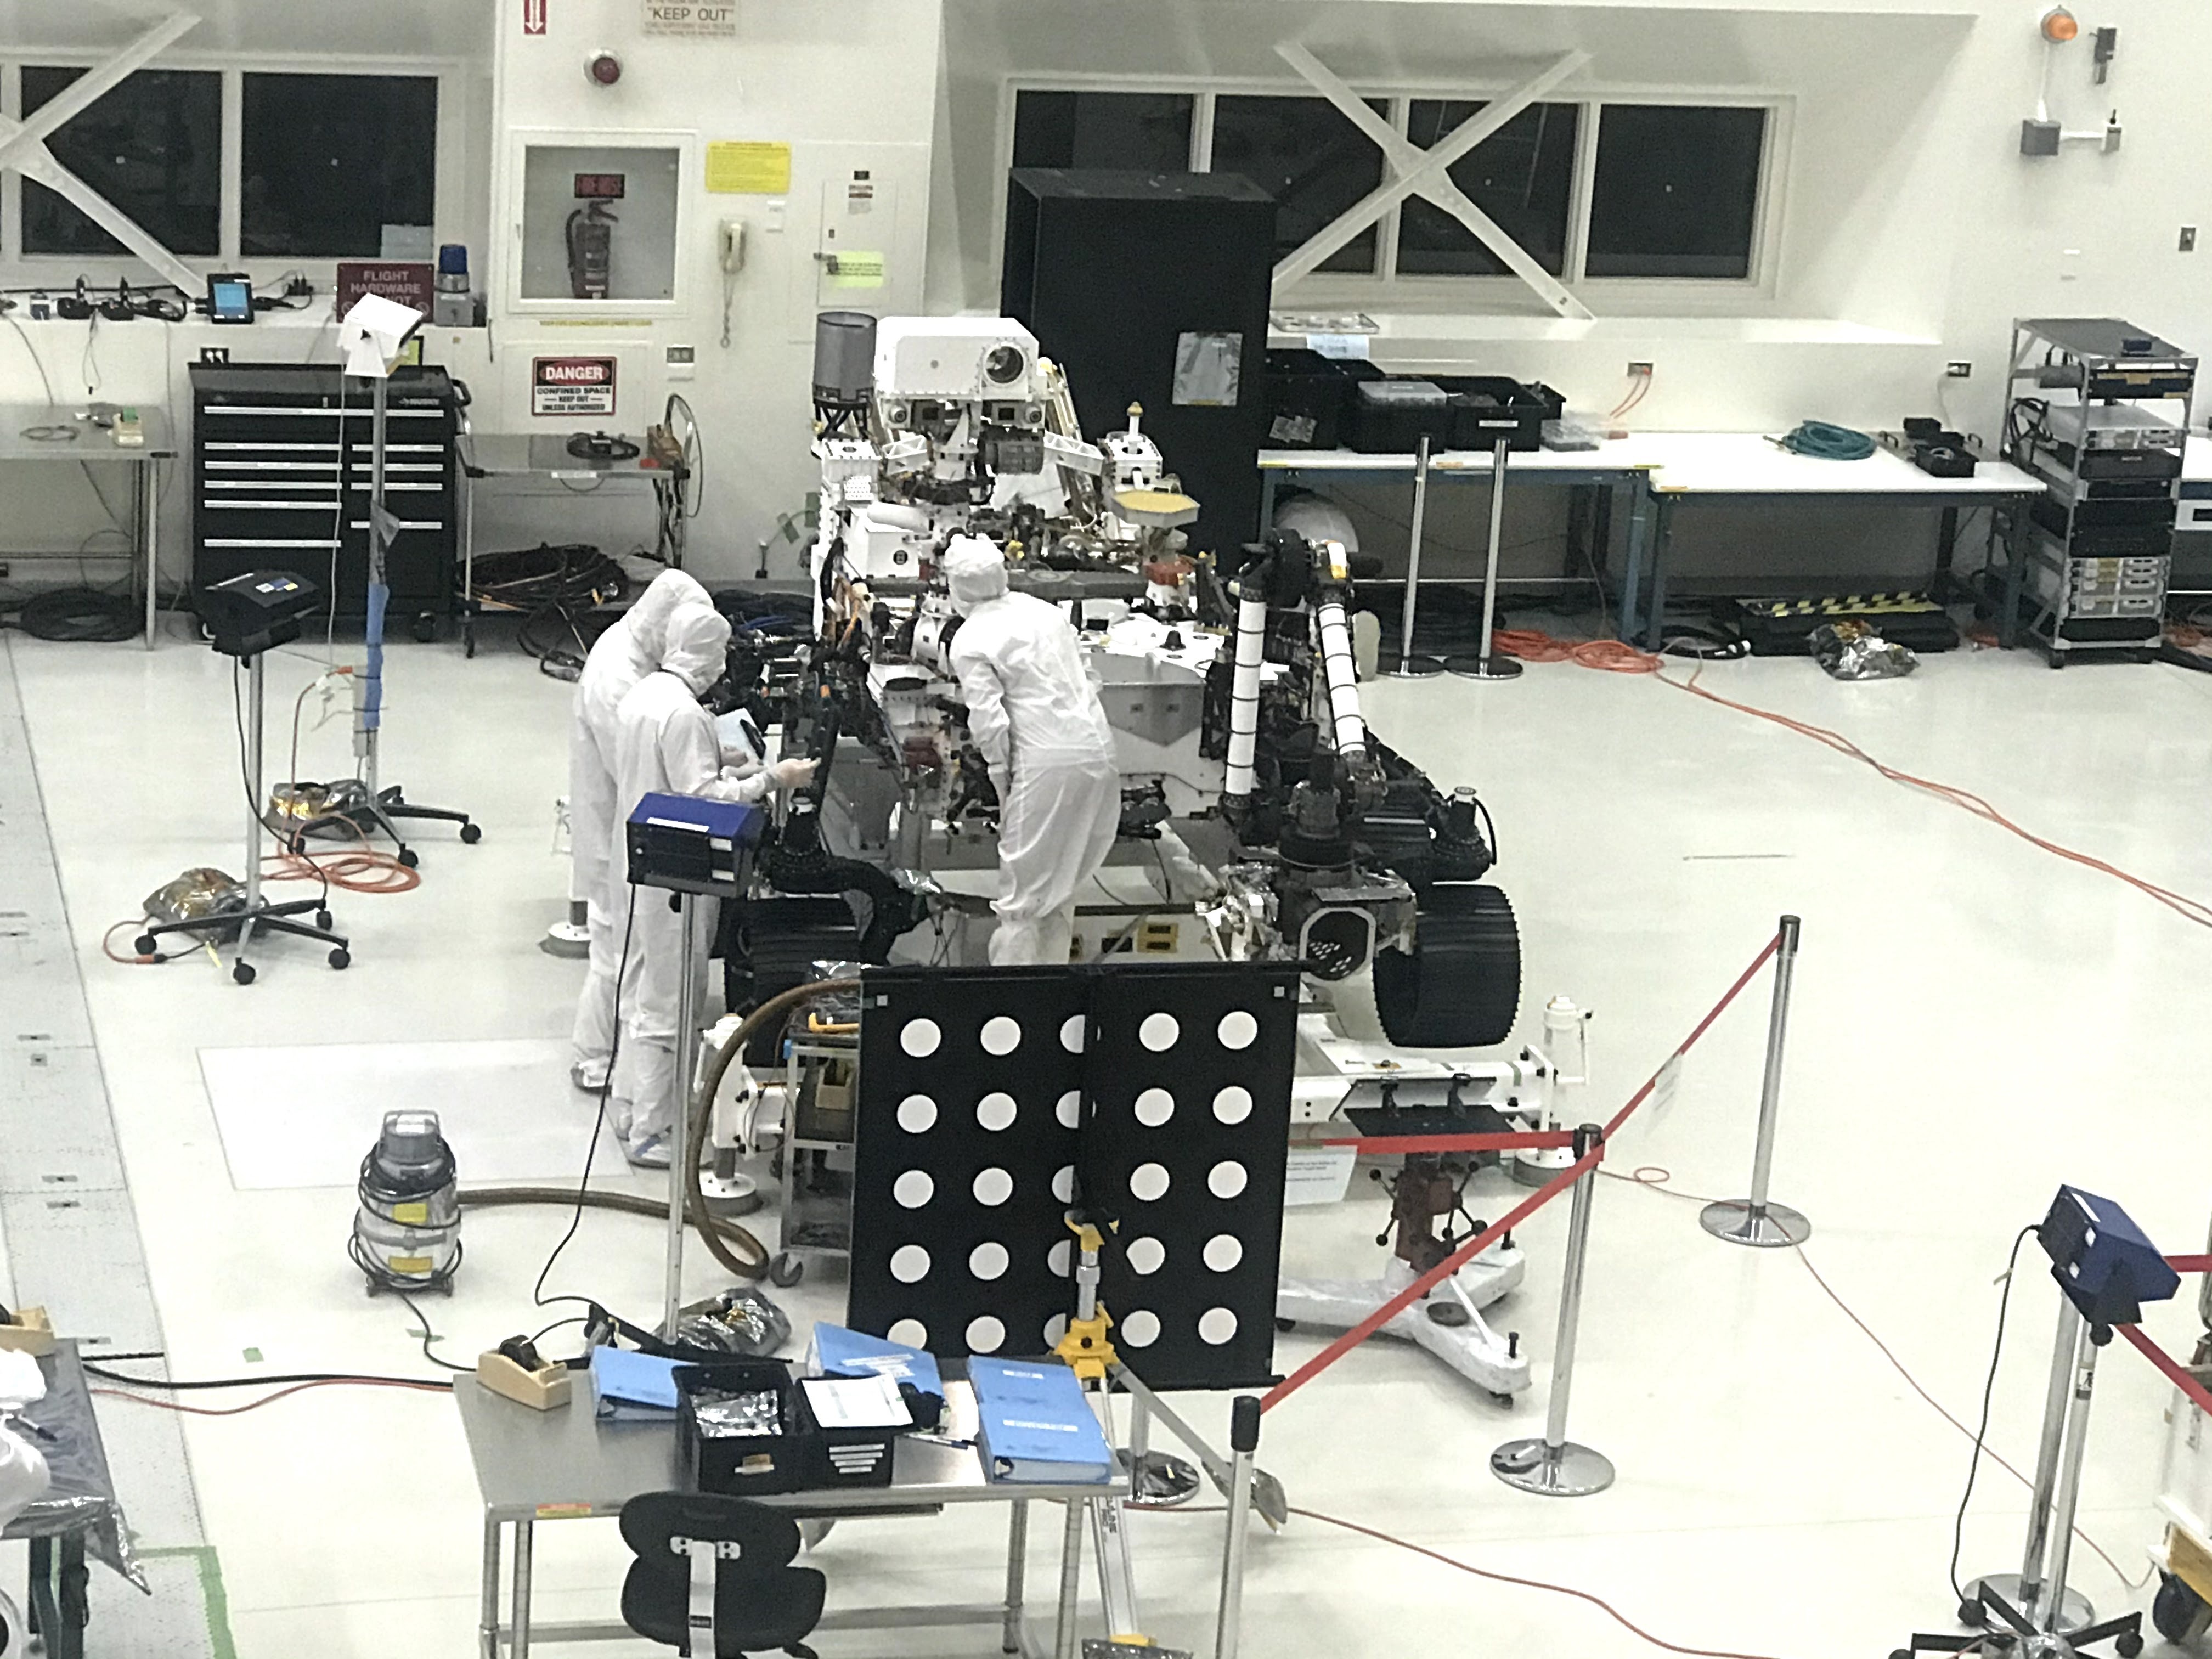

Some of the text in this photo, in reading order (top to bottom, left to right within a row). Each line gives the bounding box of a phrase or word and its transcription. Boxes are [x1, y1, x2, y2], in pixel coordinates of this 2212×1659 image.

[363, 270, 409, 281] FLIGHT
[351, 283, 421, 294] HARDWARE
[545, 366, 603, 380] DANGER
